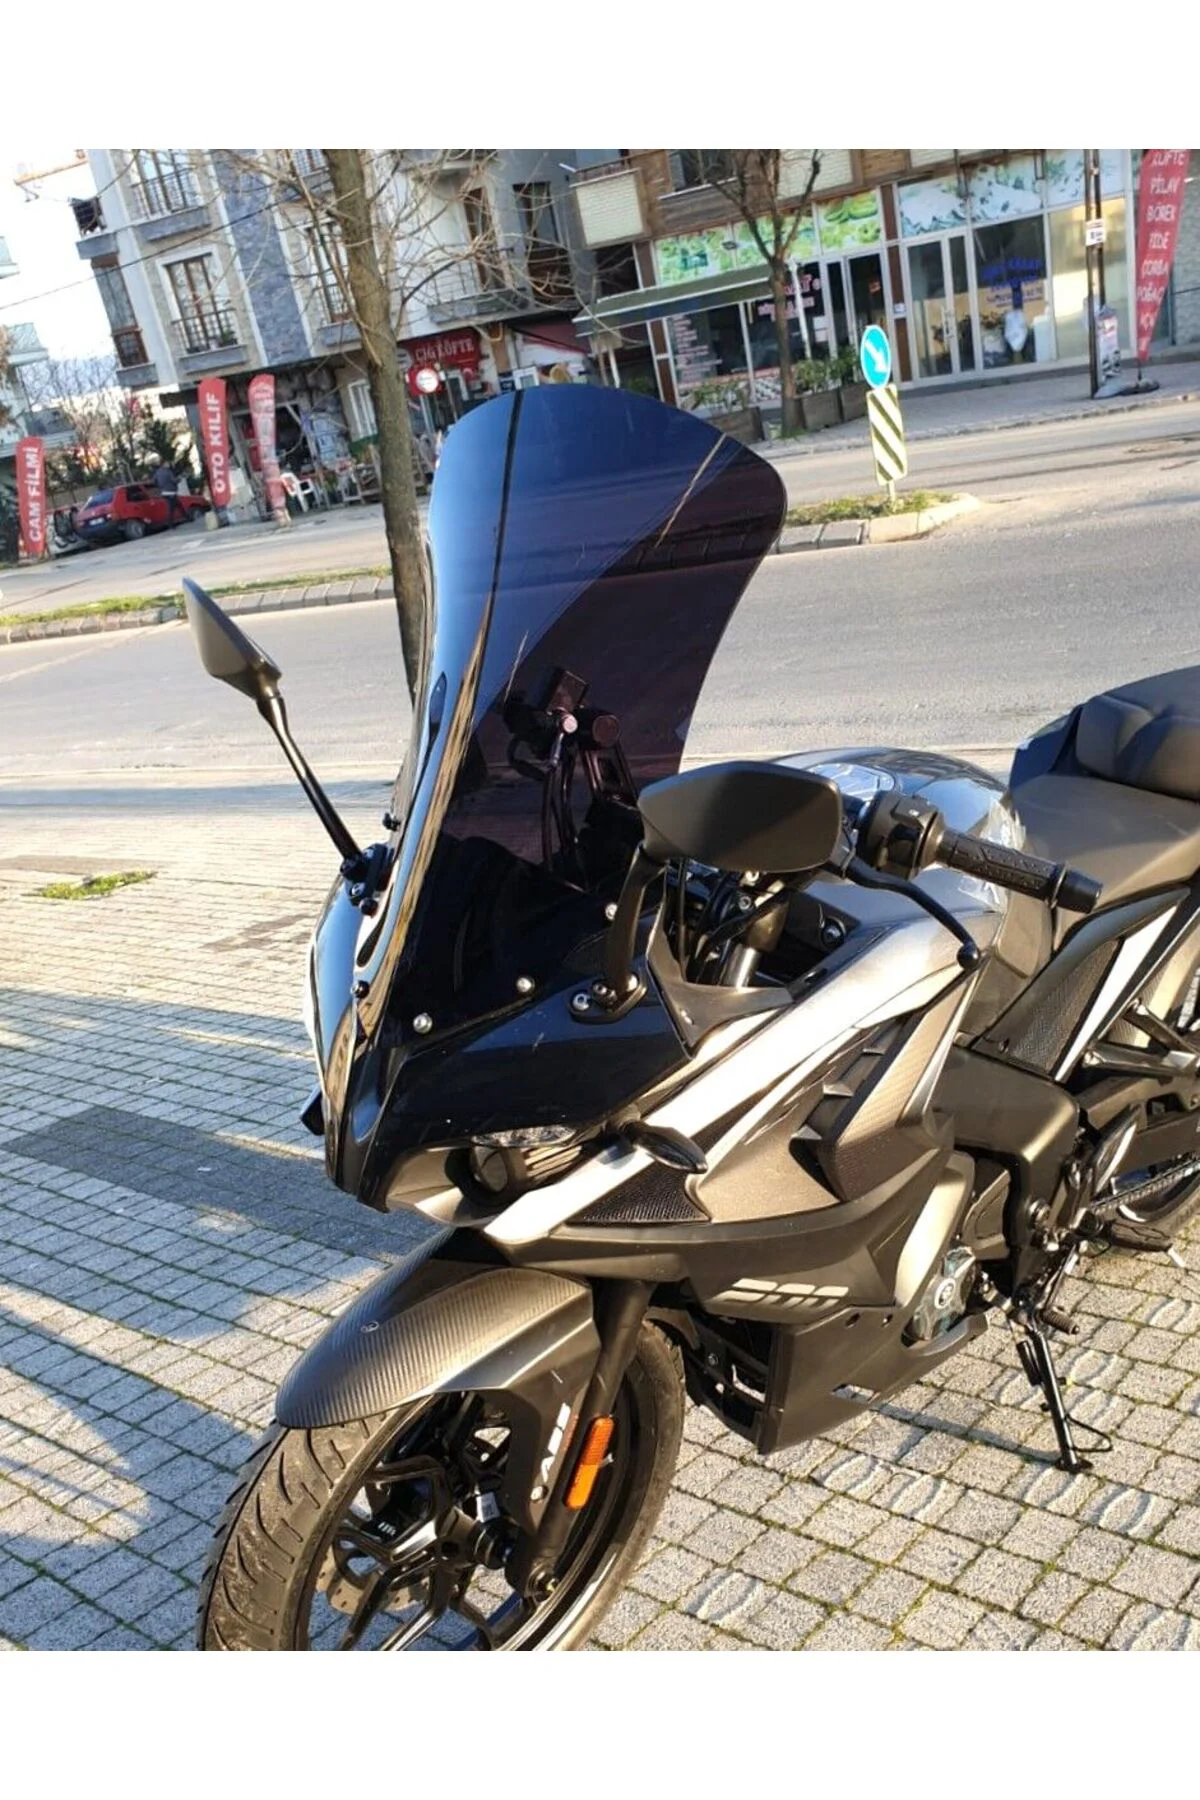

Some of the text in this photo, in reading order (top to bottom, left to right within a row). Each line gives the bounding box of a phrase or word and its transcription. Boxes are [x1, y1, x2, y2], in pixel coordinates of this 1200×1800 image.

[205, 392, 226, 493] OTO KILIF
[22, 447, 42, 542] CAM FİLMİ
